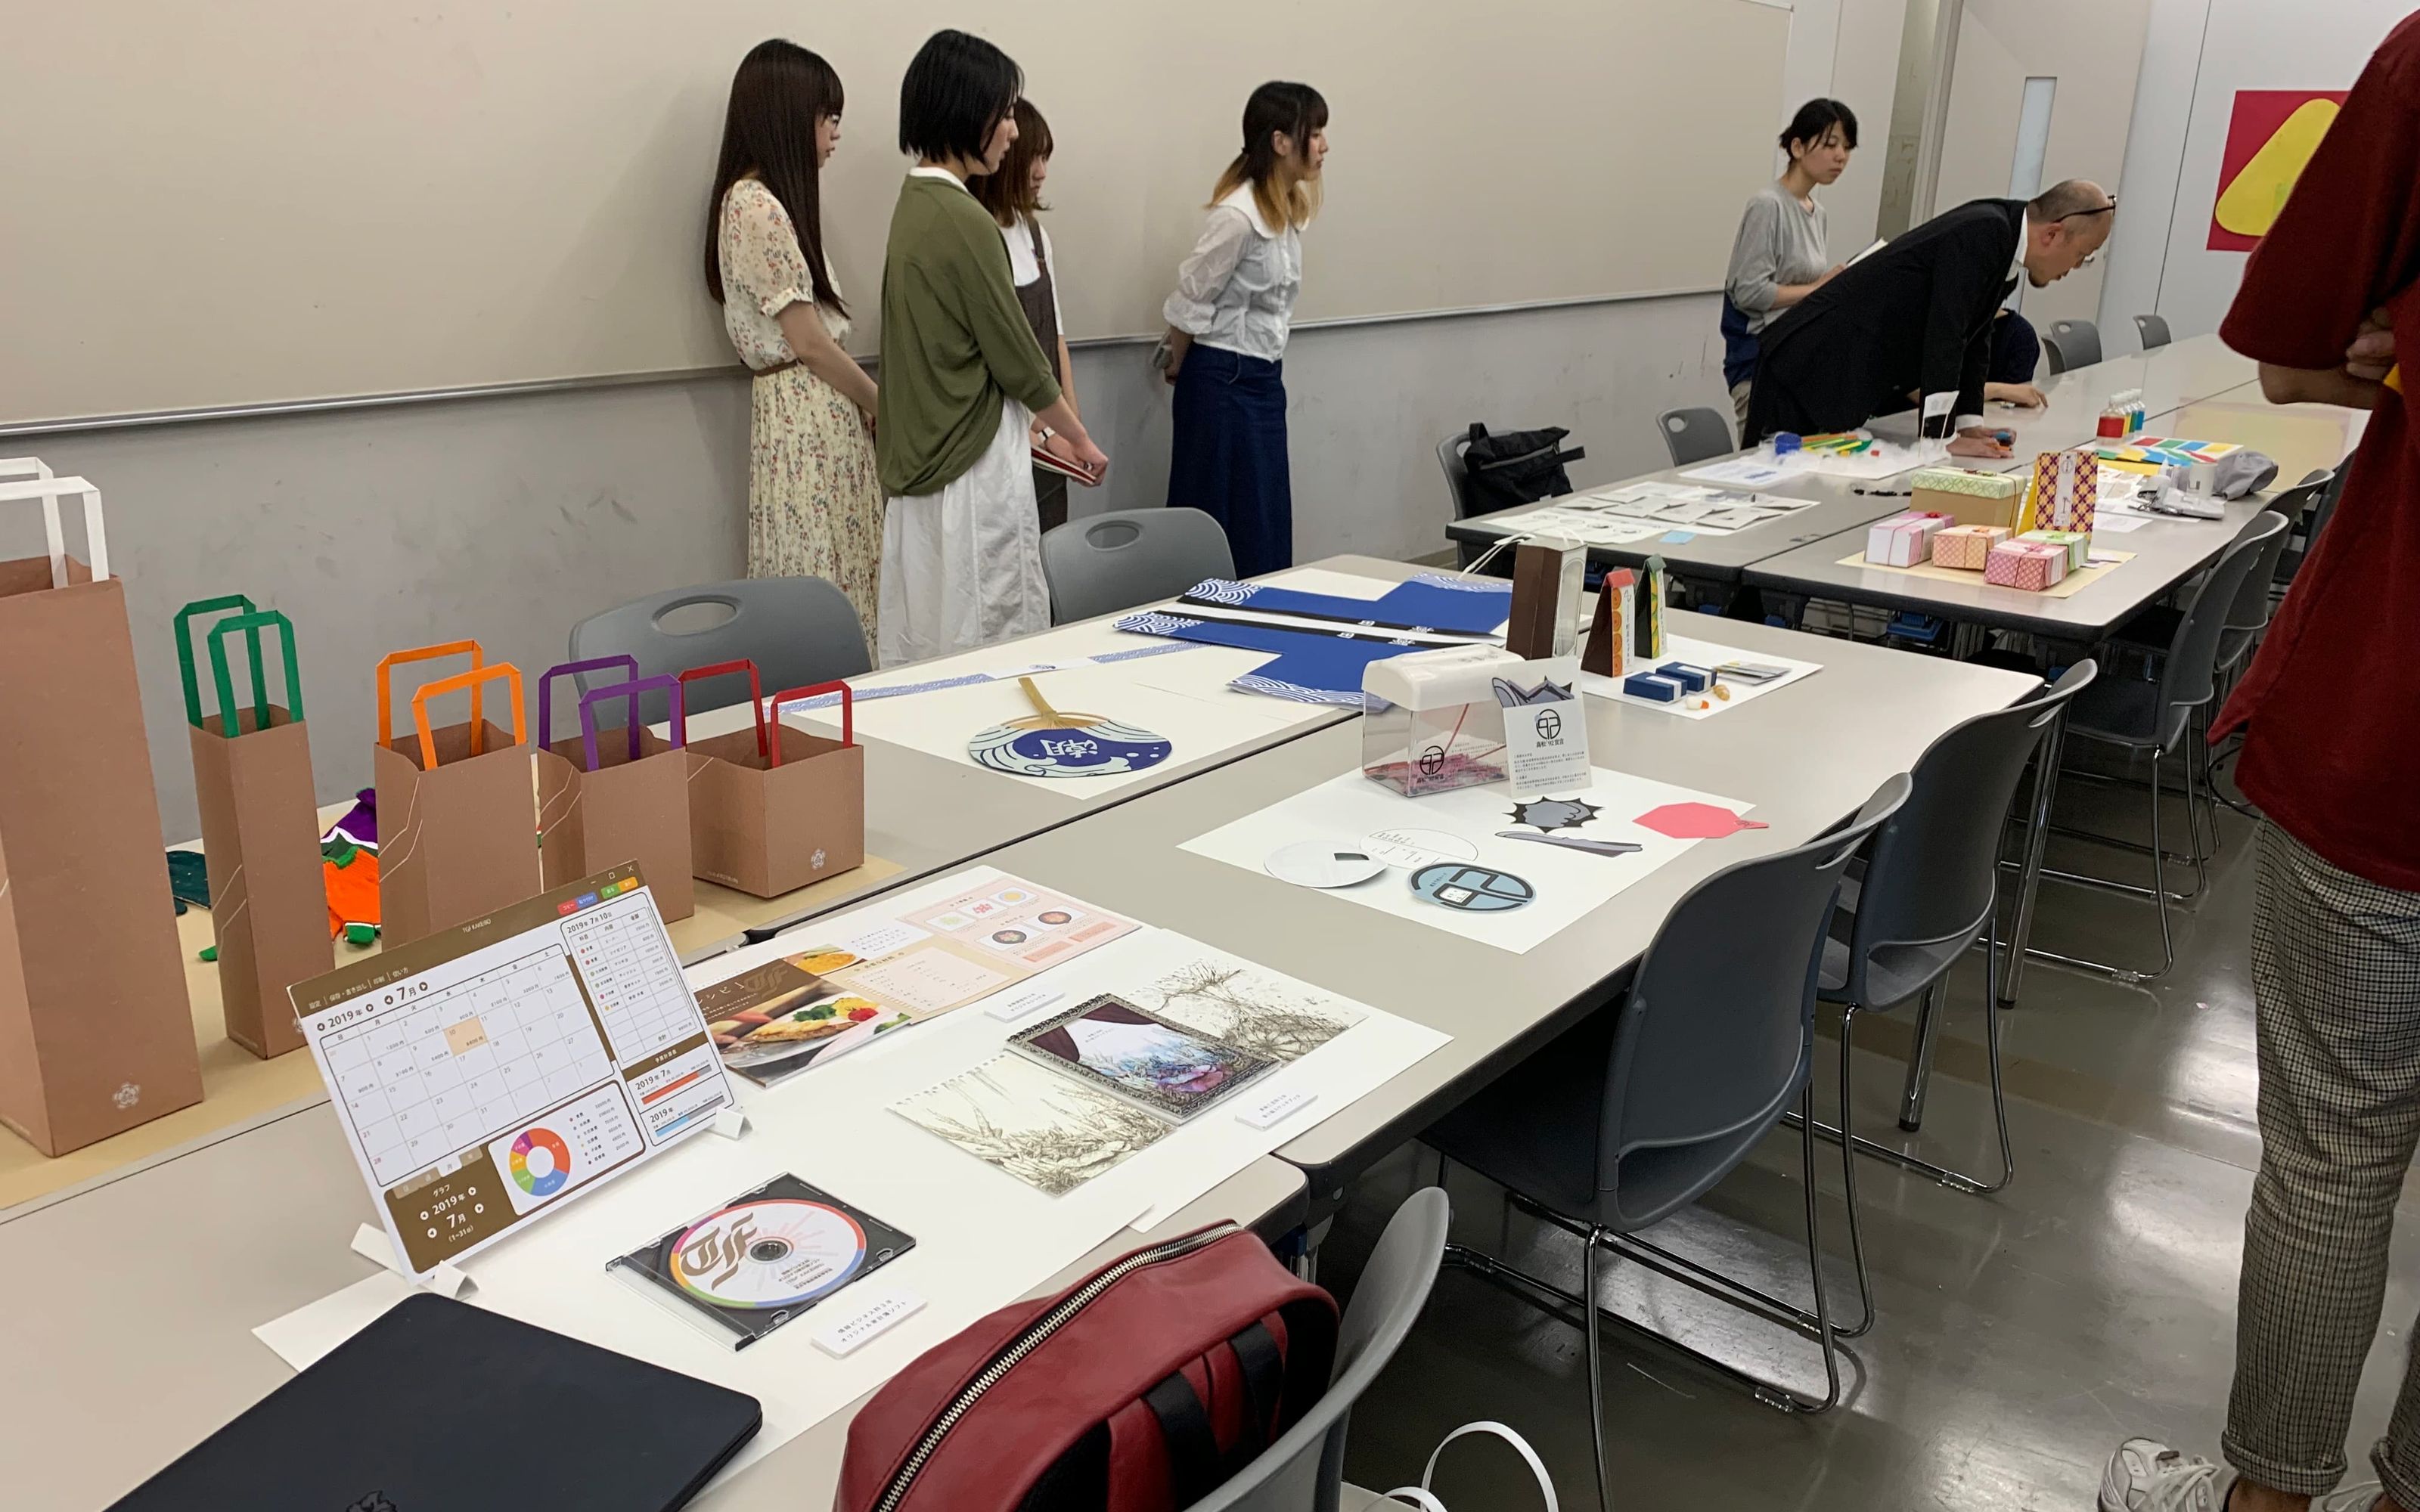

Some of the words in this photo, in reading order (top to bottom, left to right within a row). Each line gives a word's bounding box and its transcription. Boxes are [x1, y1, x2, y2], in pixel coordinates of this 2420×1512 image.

[327, 1009, 363, 1028] 2019年
[396, 987, 417, 1001] 7月
[650, 1107, 674, 1123] 2019年
[433, 1184, 451, 1198] グラフ
[432, 1193, 467, 1215] 2019年
[446, 1213, 467, 1228] 7月
